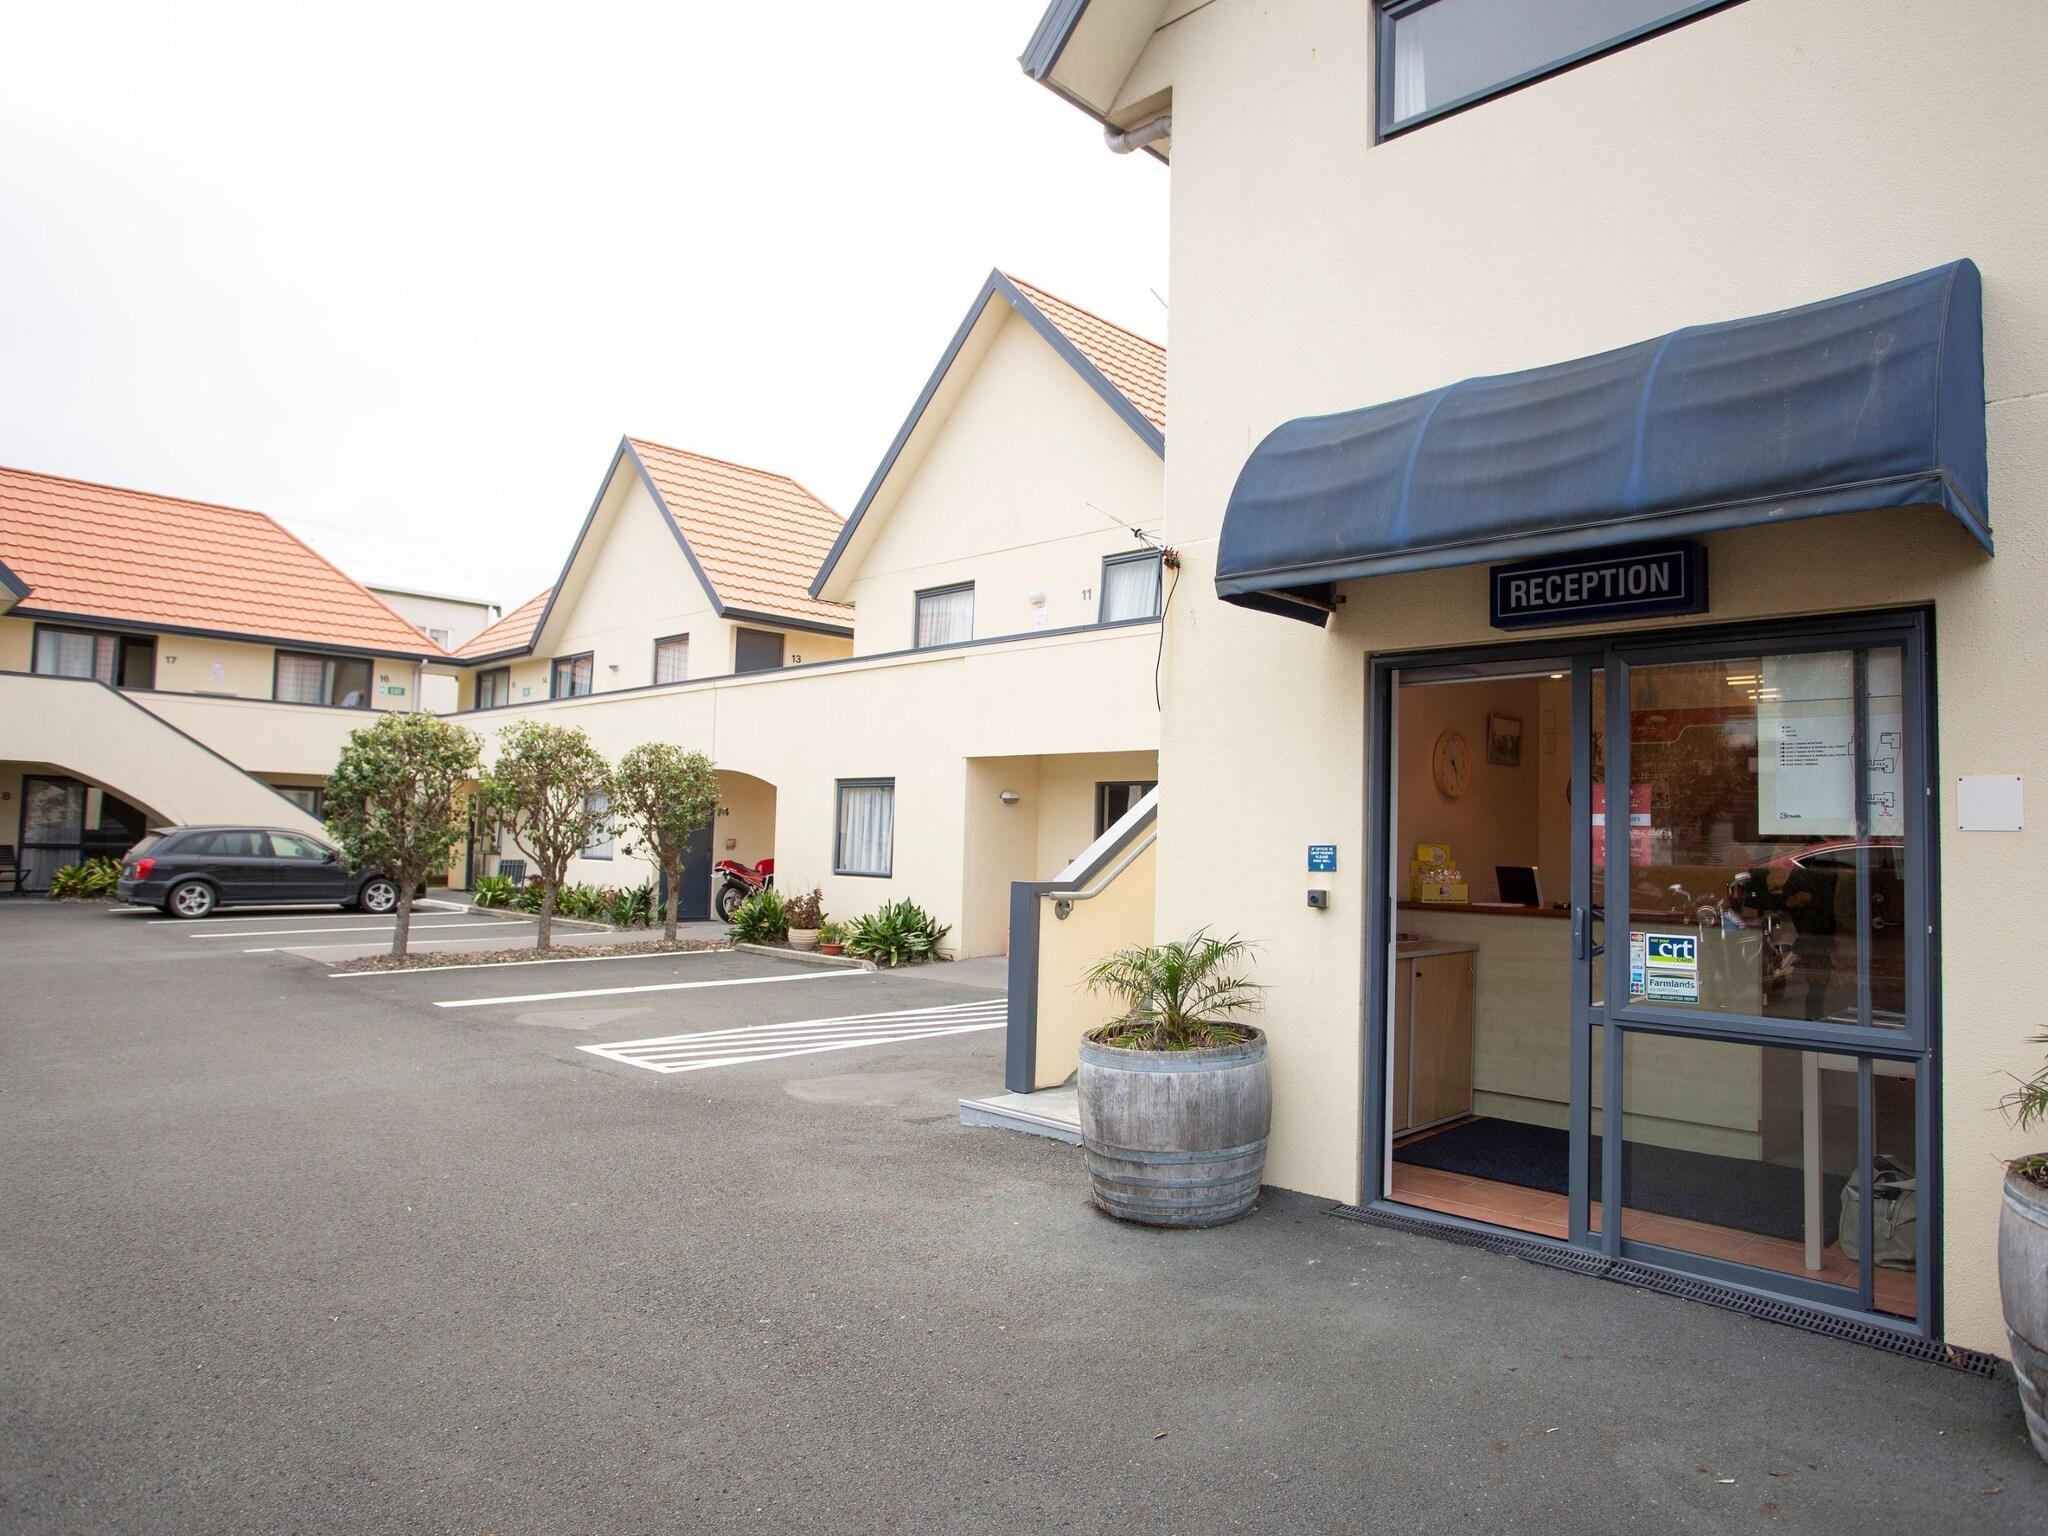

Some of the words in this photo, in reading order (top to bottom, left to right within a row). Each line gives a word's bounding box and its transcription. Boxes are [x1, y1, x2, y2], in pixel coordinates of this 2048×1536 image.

[1510, 561, 1669, 608] RECEPTION
[1081, 588, 1092, 601] 11
[165, 656, 177, 664] 17
[792, 654, 802, 664] 13
[380, 674, 391, 683] 16
[1659, 940, 1693, 959] crt
[1649, 979, 1695, 989] Farmlands
